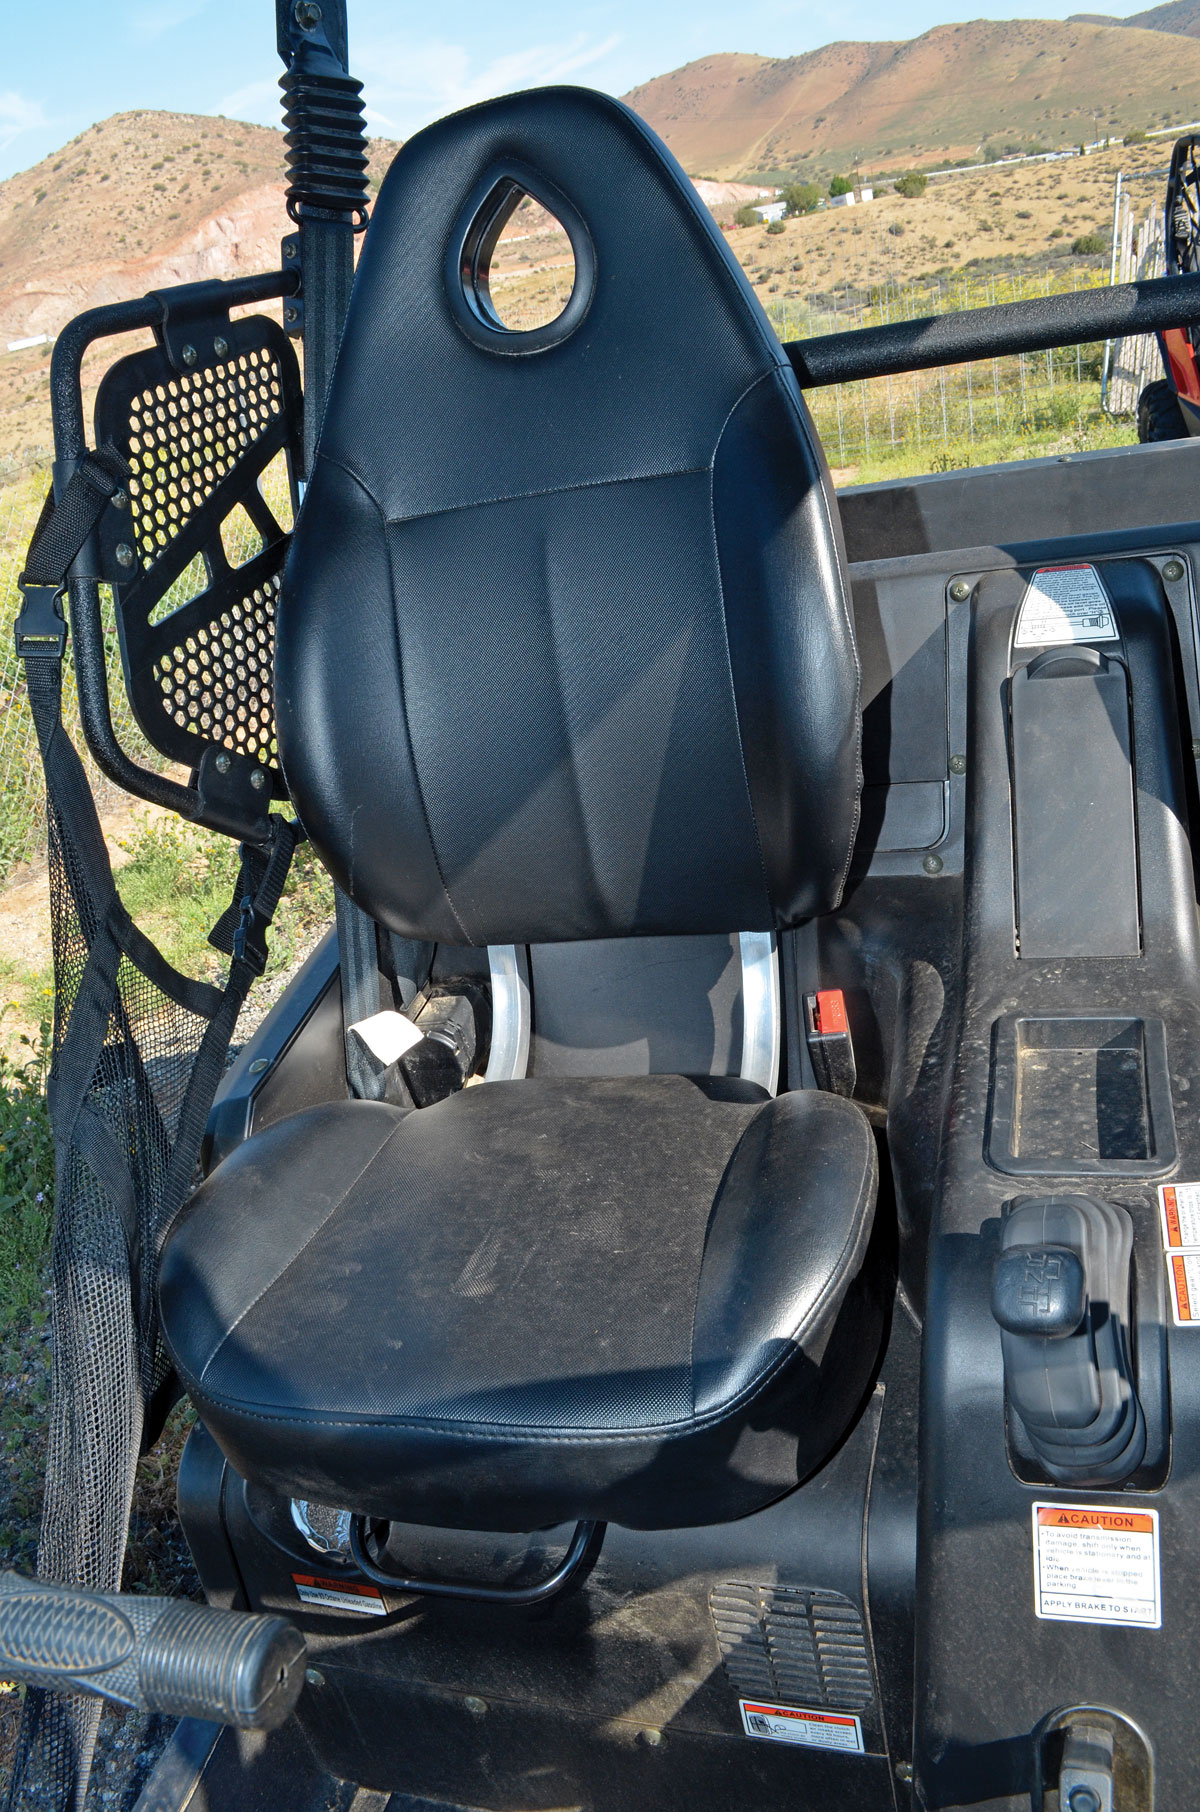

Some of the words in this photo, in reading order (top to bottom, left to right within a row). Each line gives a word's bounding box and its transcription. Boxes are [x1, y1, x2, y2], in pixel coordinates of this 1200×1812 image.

[1175, 1264, 1187, 1302] CAUTION
[1070, 1514, 1134, 1527] CAUTION
[1079, 1533, 1132, 1543] transmission
[1046, 1563, 1070, 1571] When
[1046, 1572, 1069, 1581] place
[1046, 1581, 1077, 1590] parking
[1043, 1600, 1072, 1609] APPLY
[1074, 1602, 1107, 1611] BRAKE
[1109, 1604, 1121, 1613] TO
[782, 1711, 825, 1721] CAUTION
